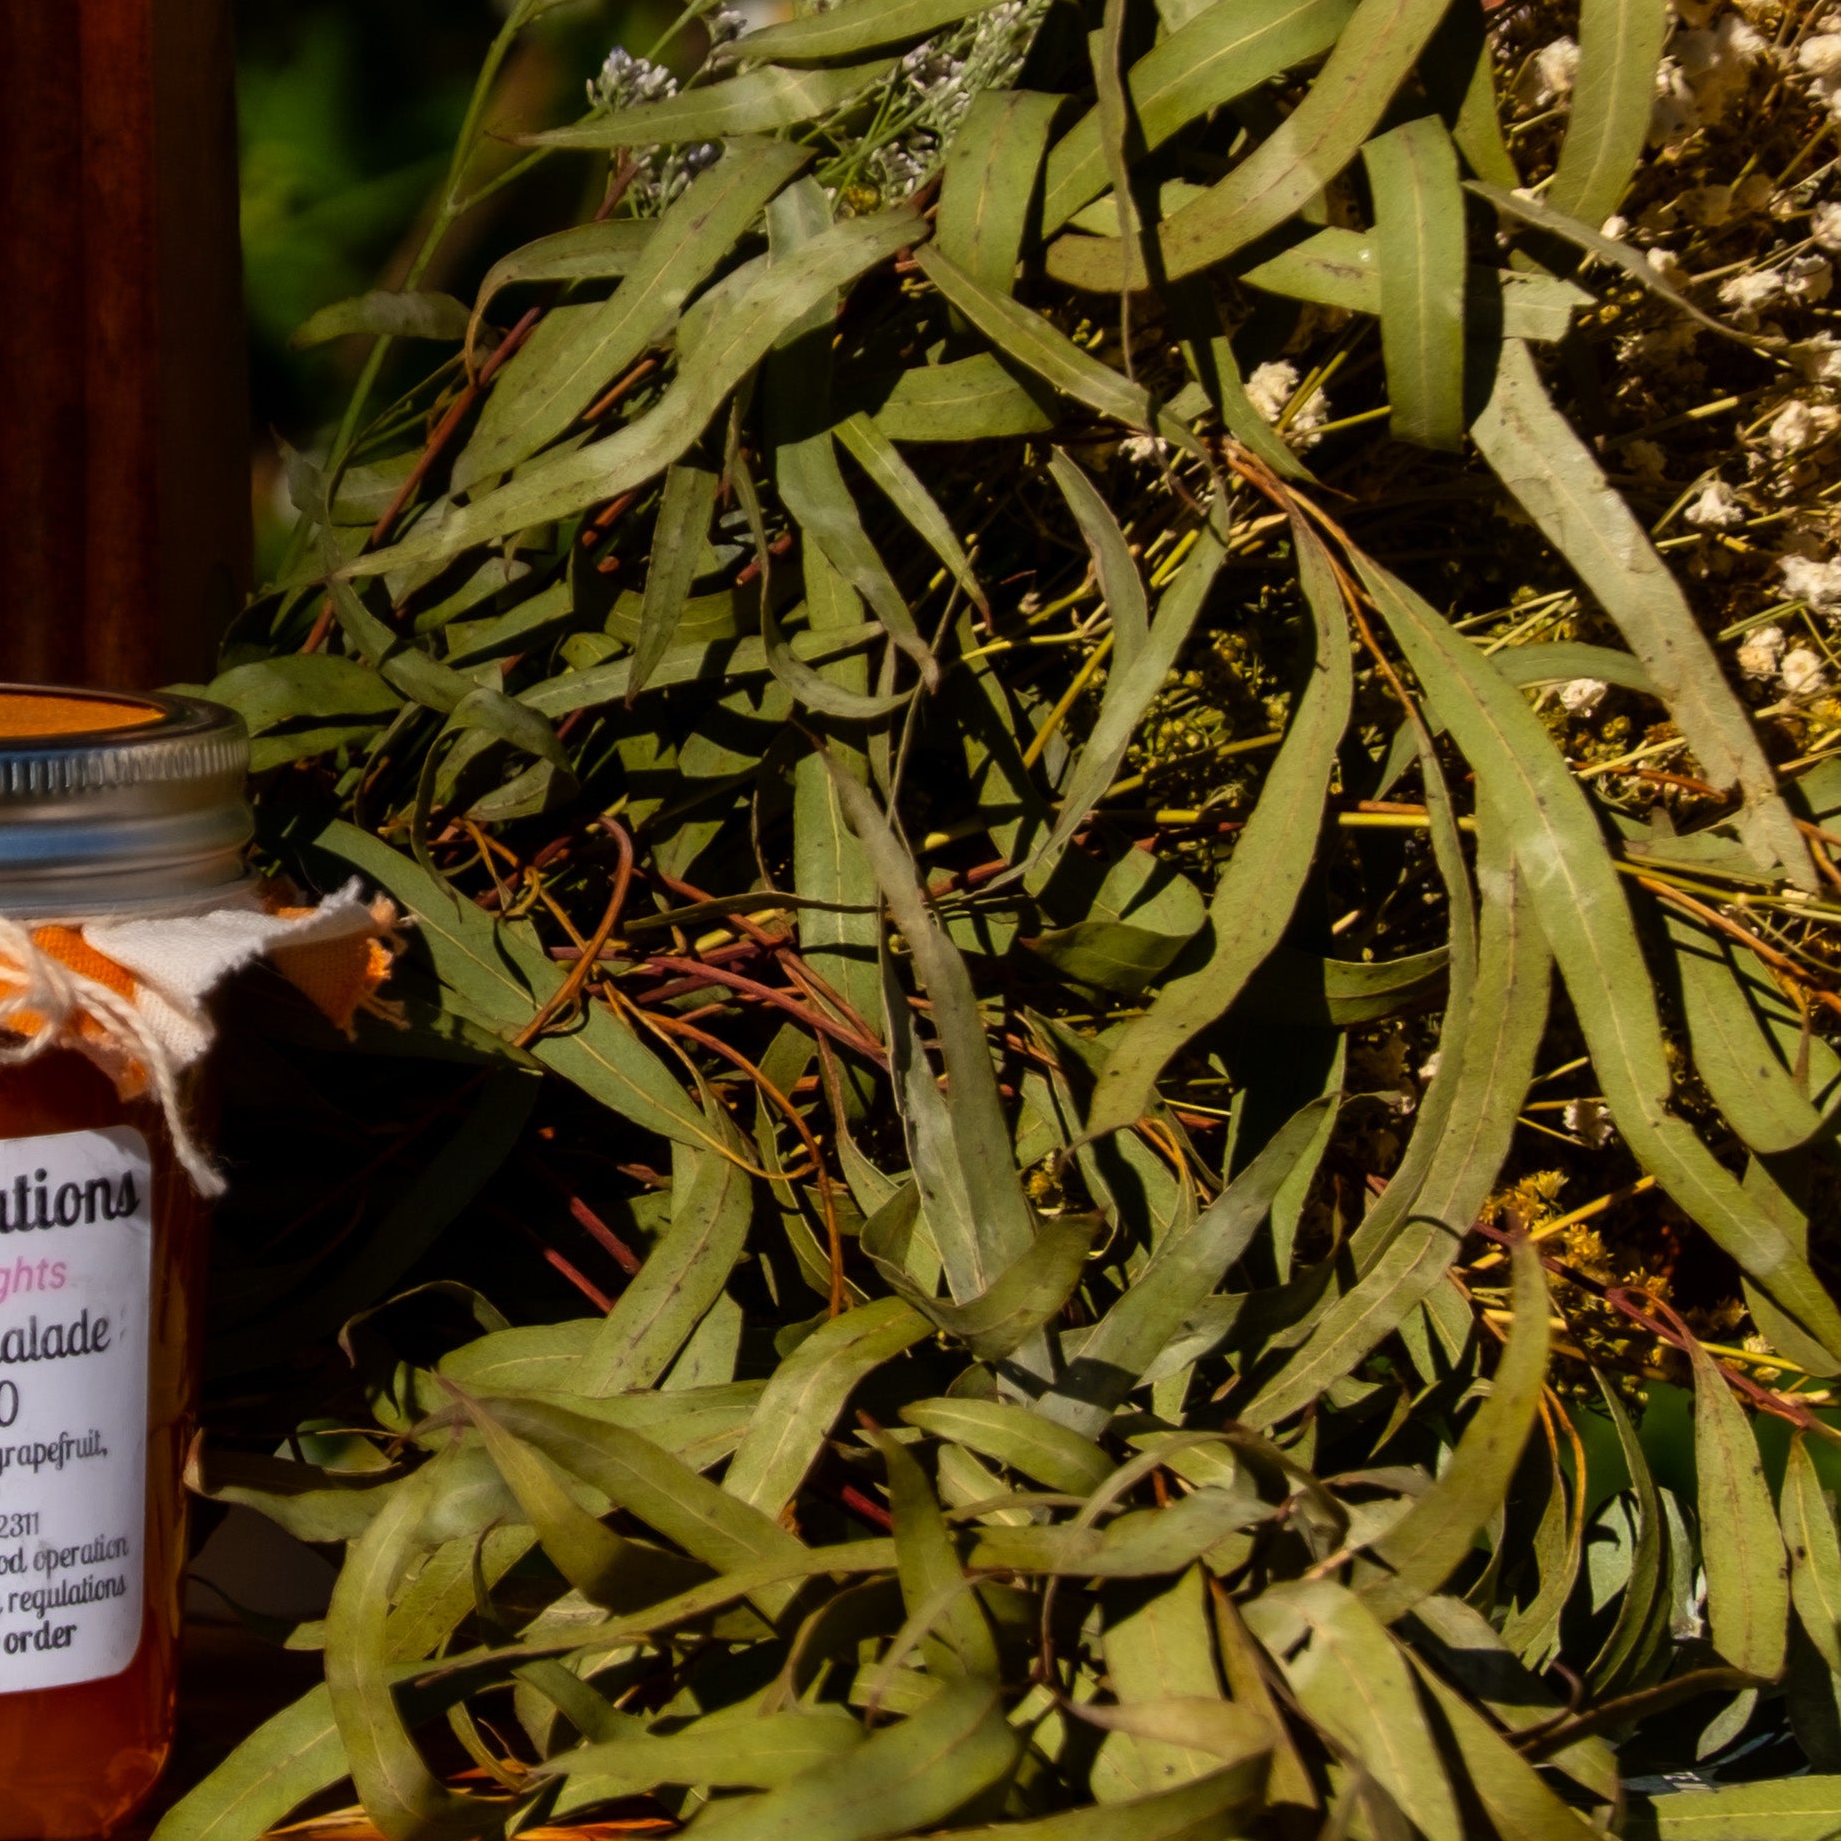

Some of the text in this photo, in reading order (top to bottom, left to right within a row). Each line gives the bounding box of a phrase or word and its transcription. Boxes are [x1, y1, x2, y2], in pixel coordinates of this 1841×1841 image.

[32, 1533, 129, 1580] operation
[8, 1573, 128, 1620] regulations
[3, 1620, 78, 1655] order
